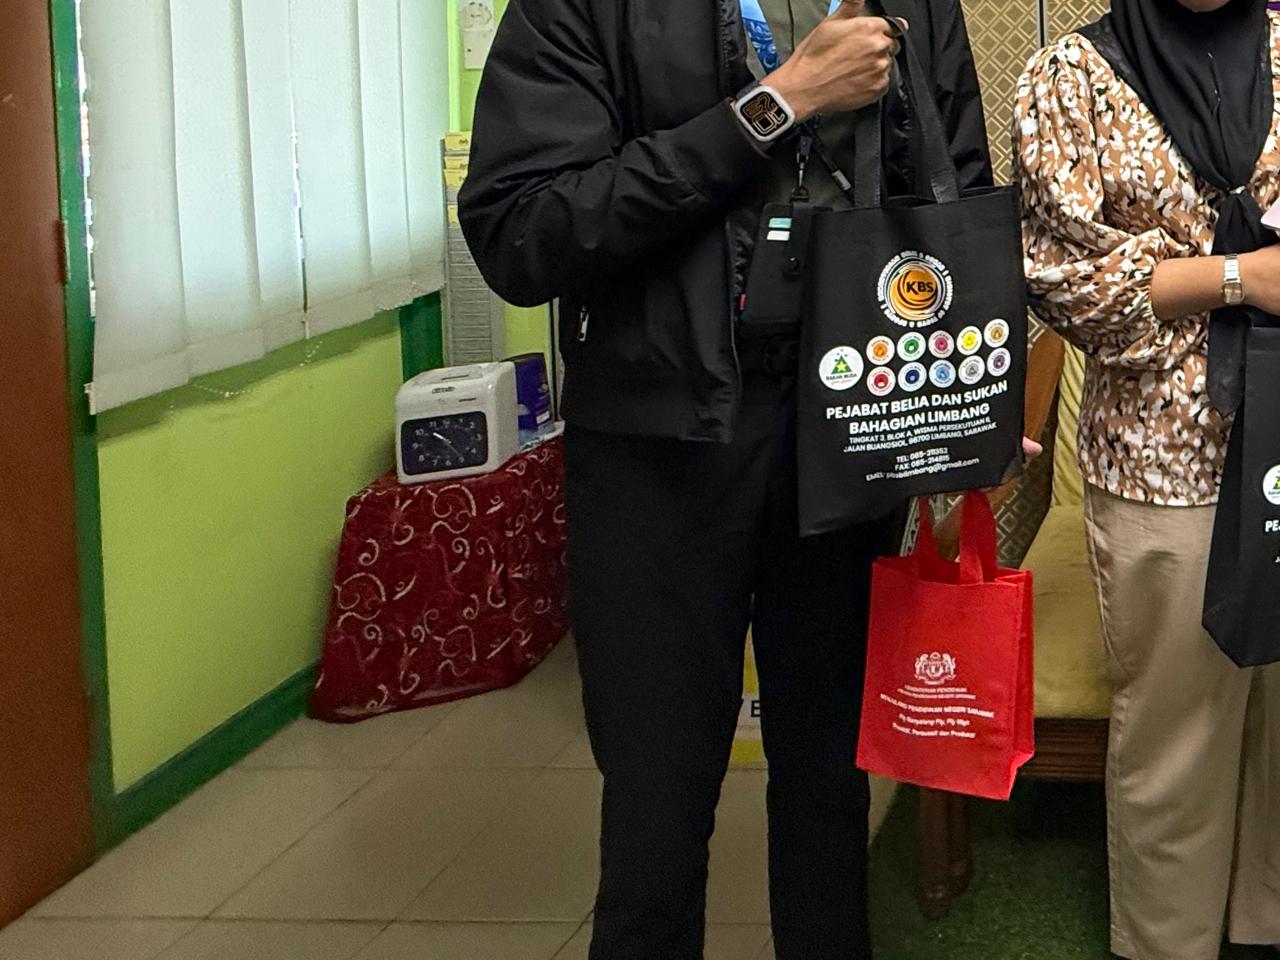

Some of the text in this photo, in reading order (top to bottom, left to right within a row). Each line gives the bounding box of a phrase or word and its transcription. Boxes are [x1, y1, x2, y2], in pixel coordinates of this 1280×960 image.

[906, 281, 934, 295] KBS
[826, 381, 1008, 420] PEJABAT BELIA DAN SUKAN
[849, 403, 990, 435] BAHAGIAN LIMBANG
[849, 435, 879, 444] TINGKAT
[887, 432, 905, 441] BLOK
